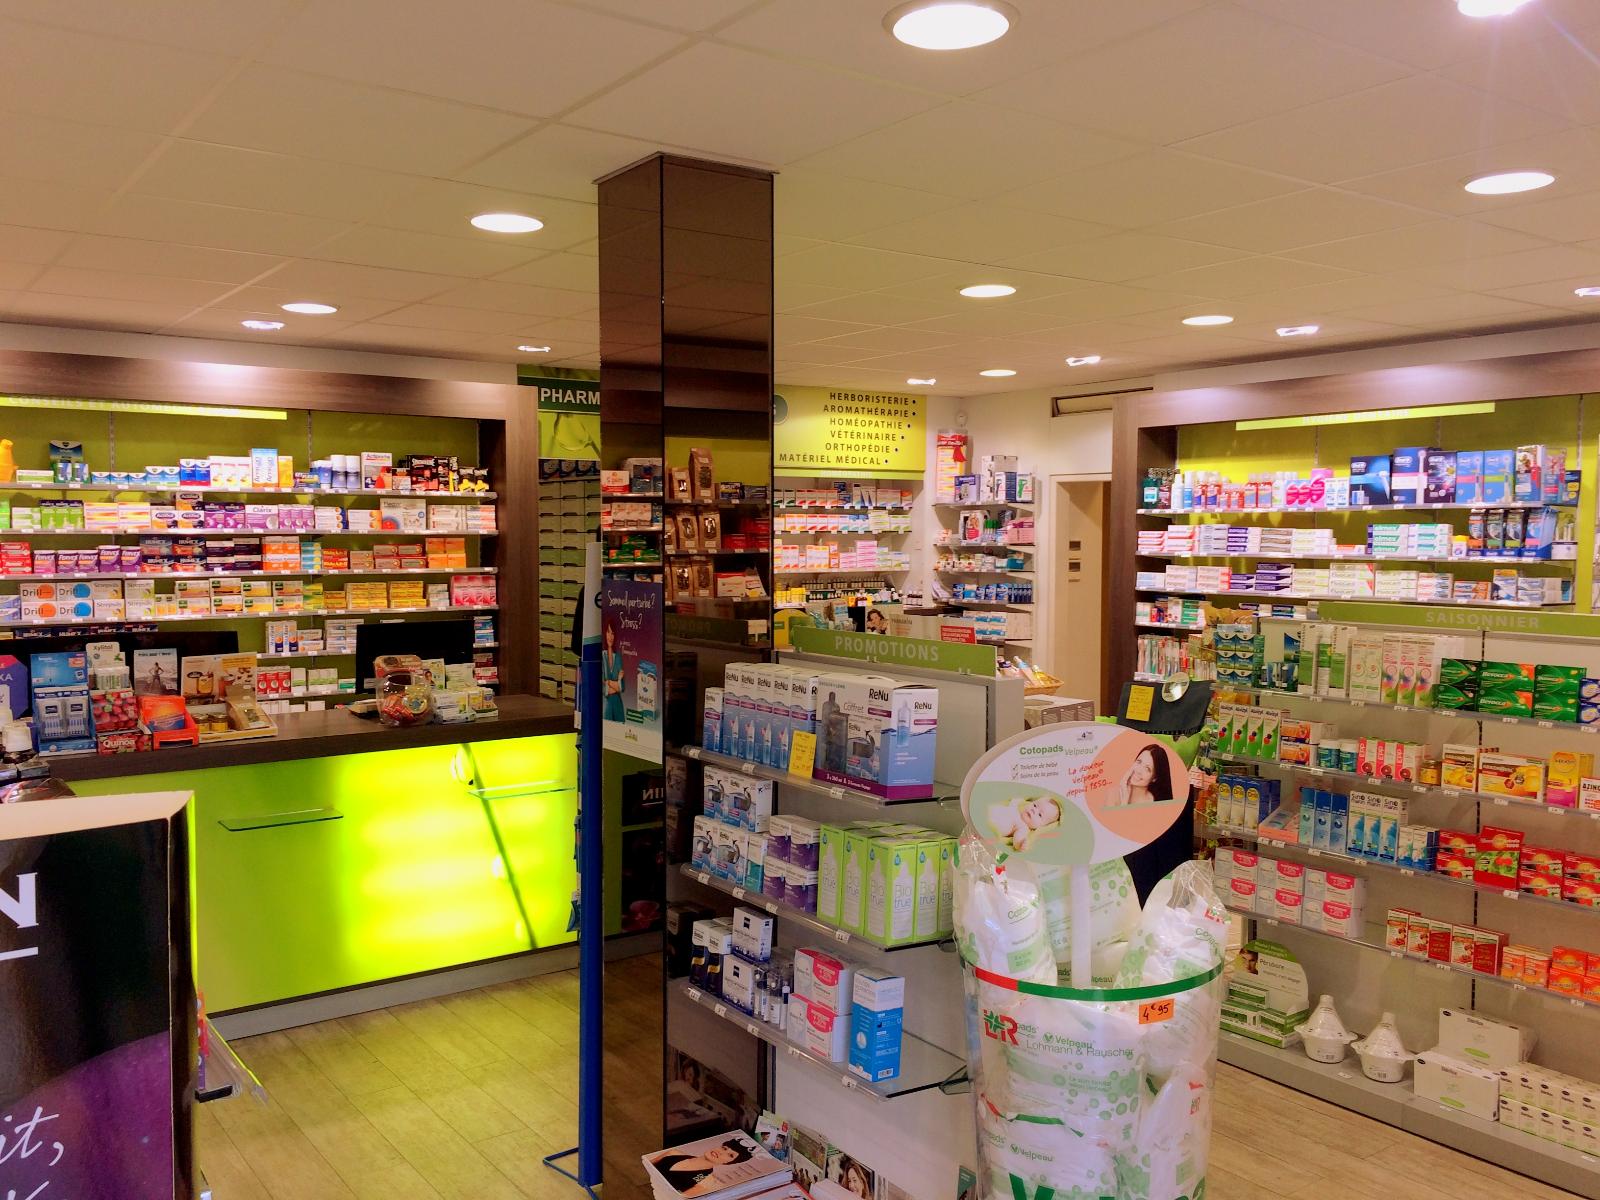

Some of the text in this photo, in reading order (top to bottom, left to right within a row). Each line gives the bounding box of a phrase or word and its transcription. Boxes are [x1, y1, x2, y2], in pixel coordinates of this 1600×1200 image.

[829, 392, 909, 406] HERBORISTERIE
[823, 404, 909, 418] AROMATHÉRAPIE
[829, 417, 903, 430] HOMÉOPATHIE
[830, 429, 897, 442] VÉTÉRINAIRE
[825, 441, 891, 454] ORTHOPÉDIE
[779, 452, 881, 466] MATÉRIEL MÉDICAL
[22, 588, 42, 597] Drill
[59, 587, 79, 596] Drill
[23, 607, 44, 616] Drill
[59, 606, 80, 615] Drill
[1426, 611, 1540, 629] SAISONNIER
[834, 635, 940, 663] PROMOTIONS
[792, 683, 807, 695] ReNu
[868, 688, 889, 702] ReNu
[914, 701, 932, 710] ReNu
[1019, 744, 1064, 756] Cotopads
[1068, 767, 1077, 775] La
[895, 885, 911, 896] Bio
[895, 897, 912, 909] true
[920, 894, 936, 906] true
[1055, 1035, 1096, 1049] Velpeau
[1026, 1039, 1134, 1059] Lohmann & Rauscher
[1018, 1148, 1054, 1163] Velpeau
